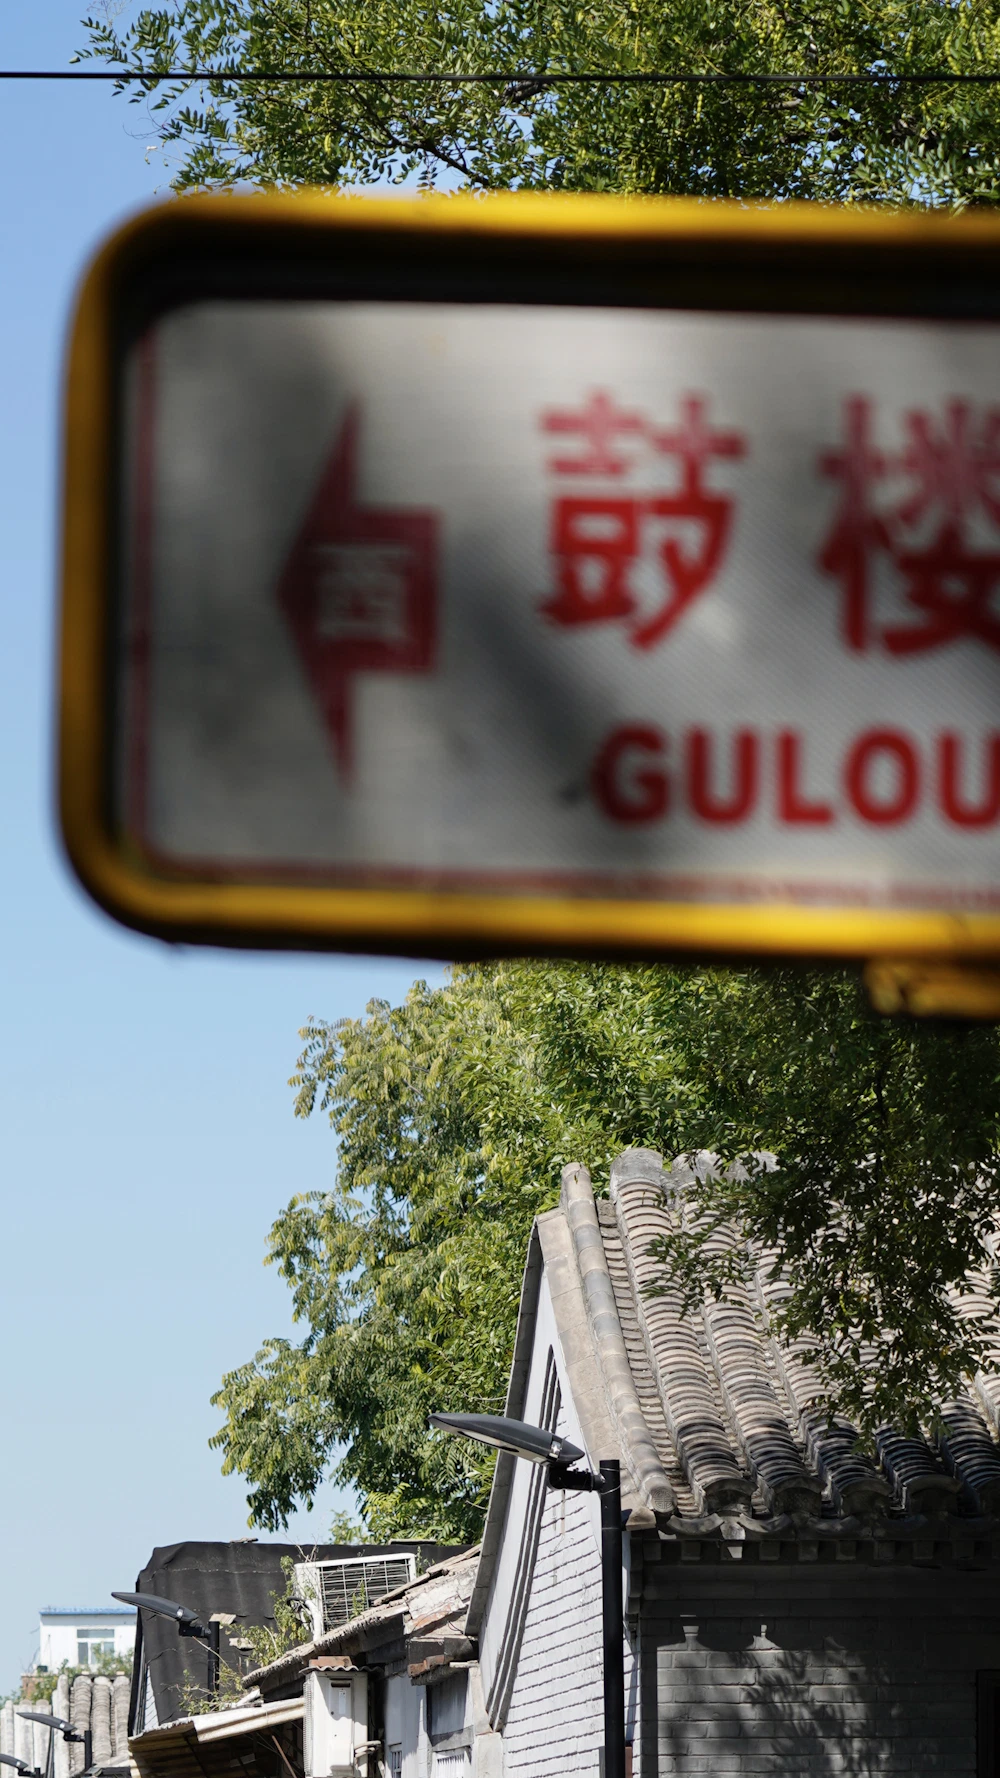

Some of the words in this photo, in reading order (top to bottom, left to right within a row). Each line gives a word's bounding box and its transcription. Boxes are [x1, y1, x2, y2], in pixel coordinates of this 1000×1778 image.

[539, 392, 1000, 658] 鼓楼
[313, 543, 412, 639] 西
[592, 725, 1000, 831] GULOU
